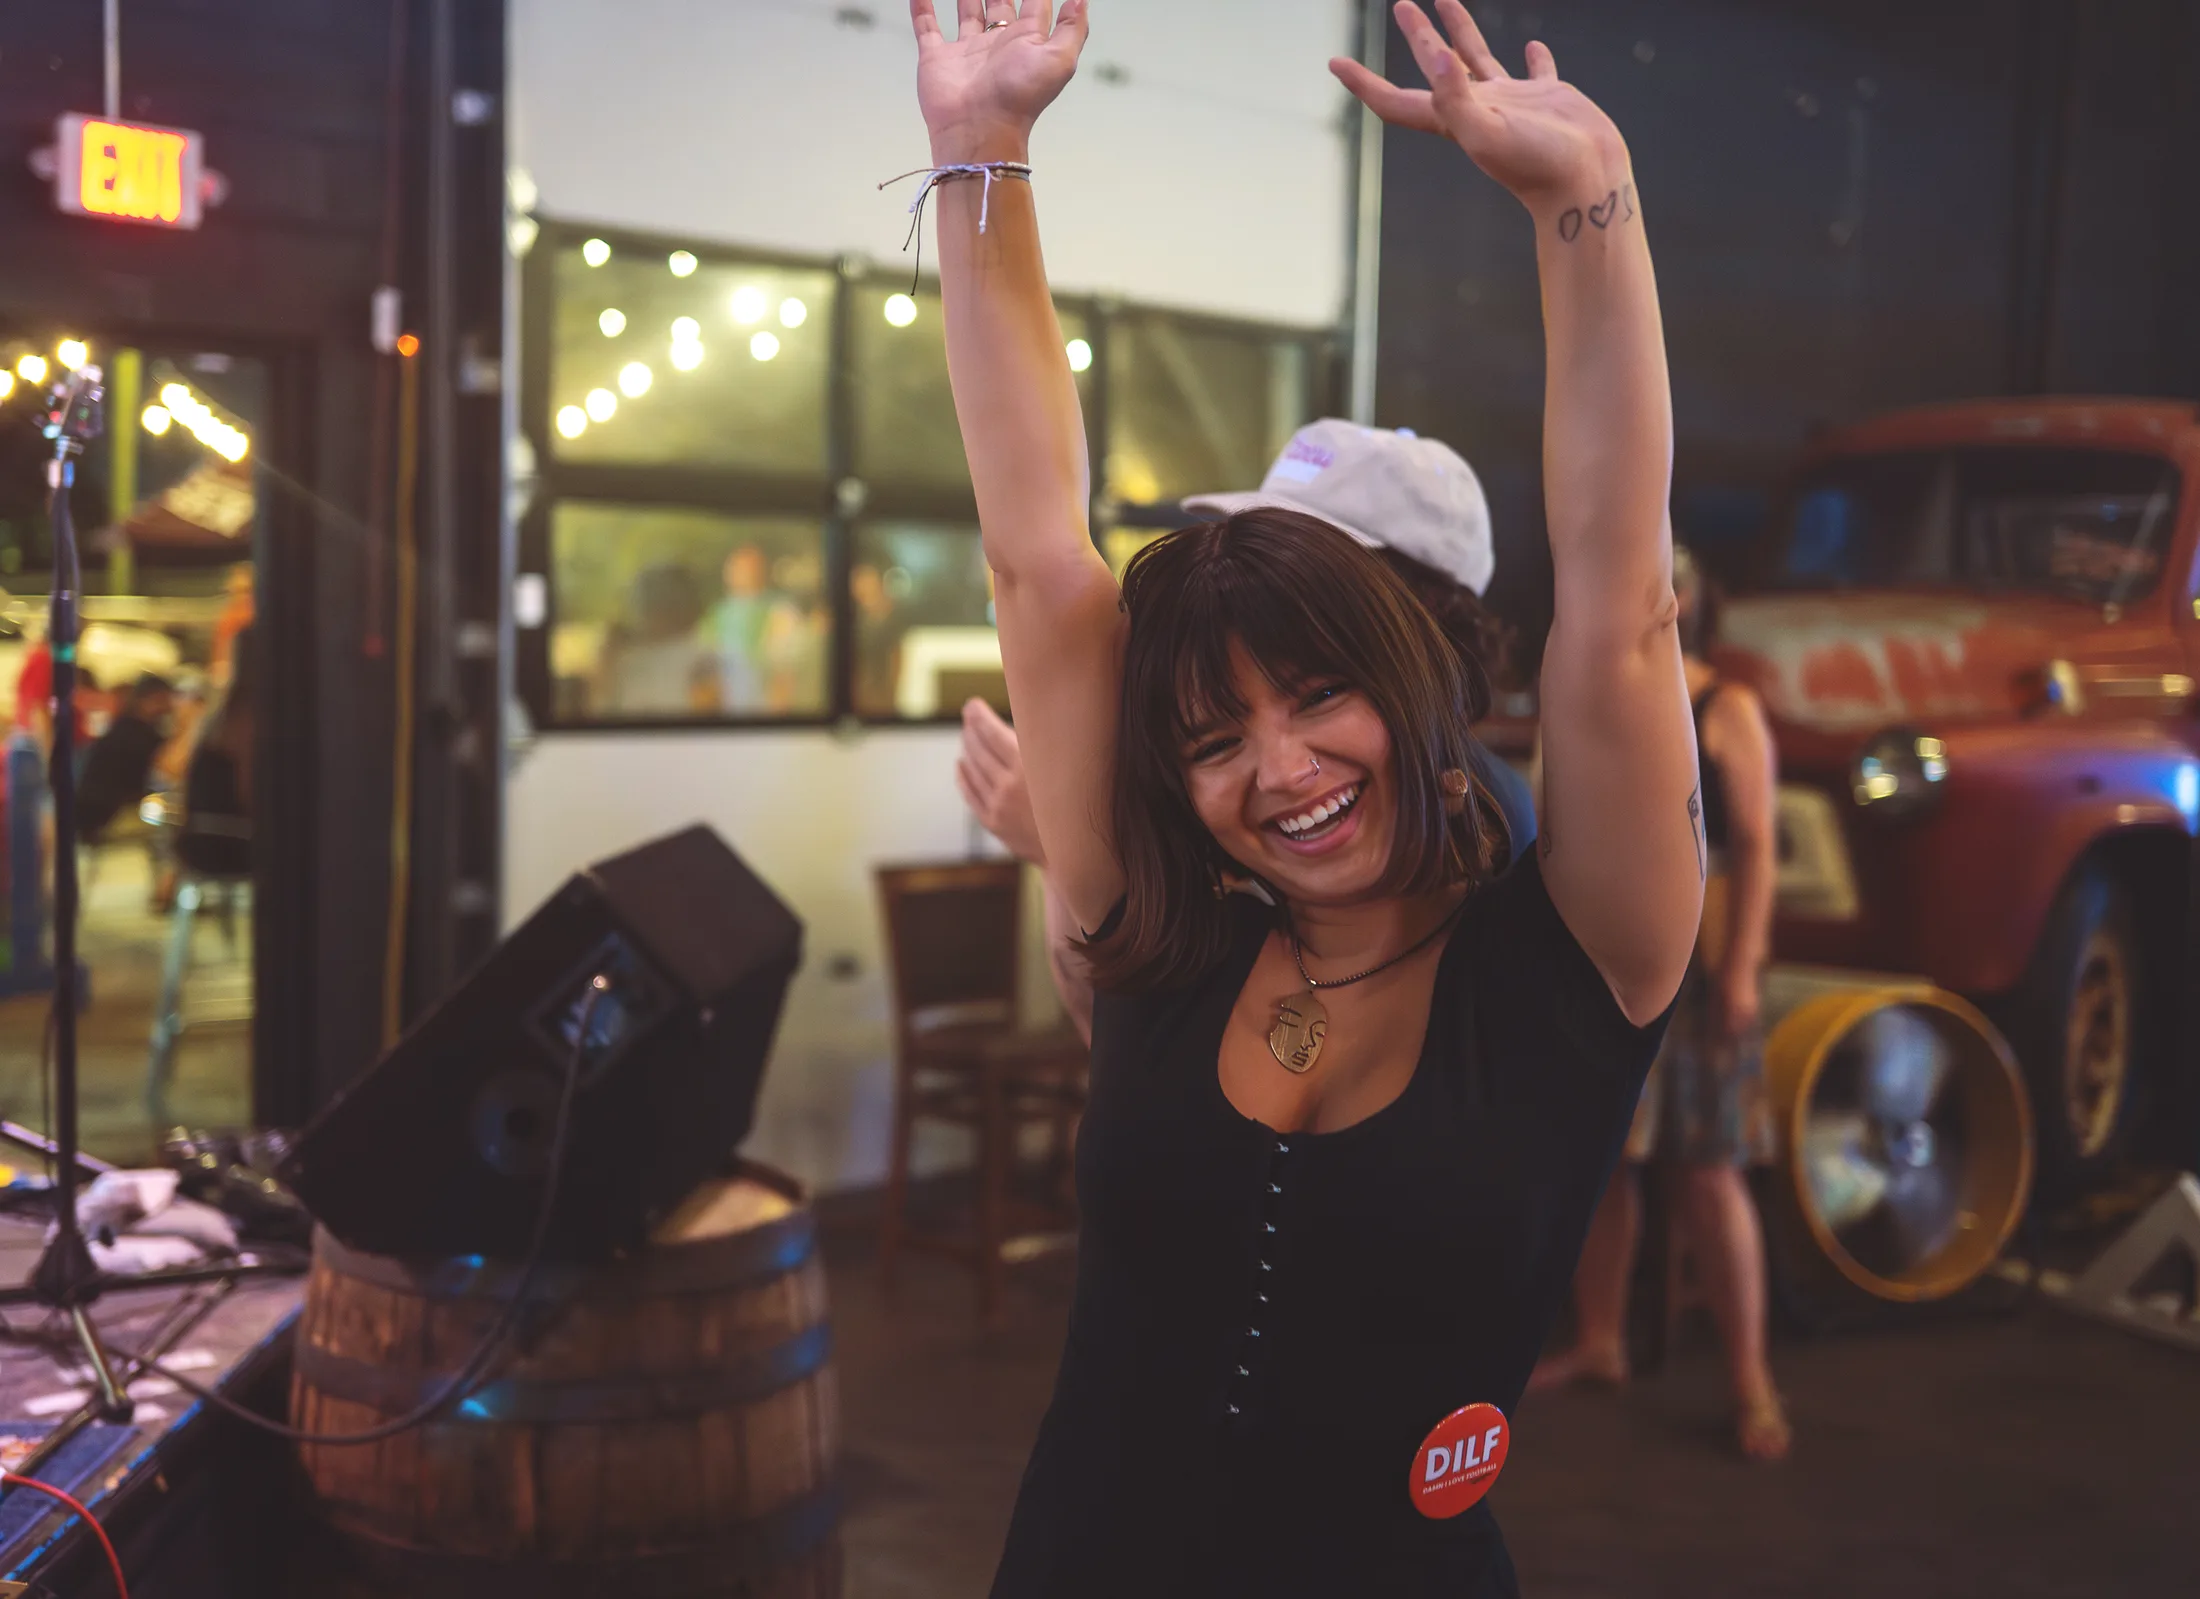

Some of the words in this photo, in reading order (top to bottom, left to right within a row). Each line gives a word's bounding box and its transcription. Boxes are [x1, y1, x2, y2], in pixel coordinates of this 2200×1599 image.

[80, 120, 188, 224] EXIT
[1422, 1483, 1443, 1495] DAMN
[1448, 1475, 1465, 1486] LOVE
[1466, 1463, 1497, 1480] FOOTBALL
[1425, 1425, 1501, 1482] DILF
